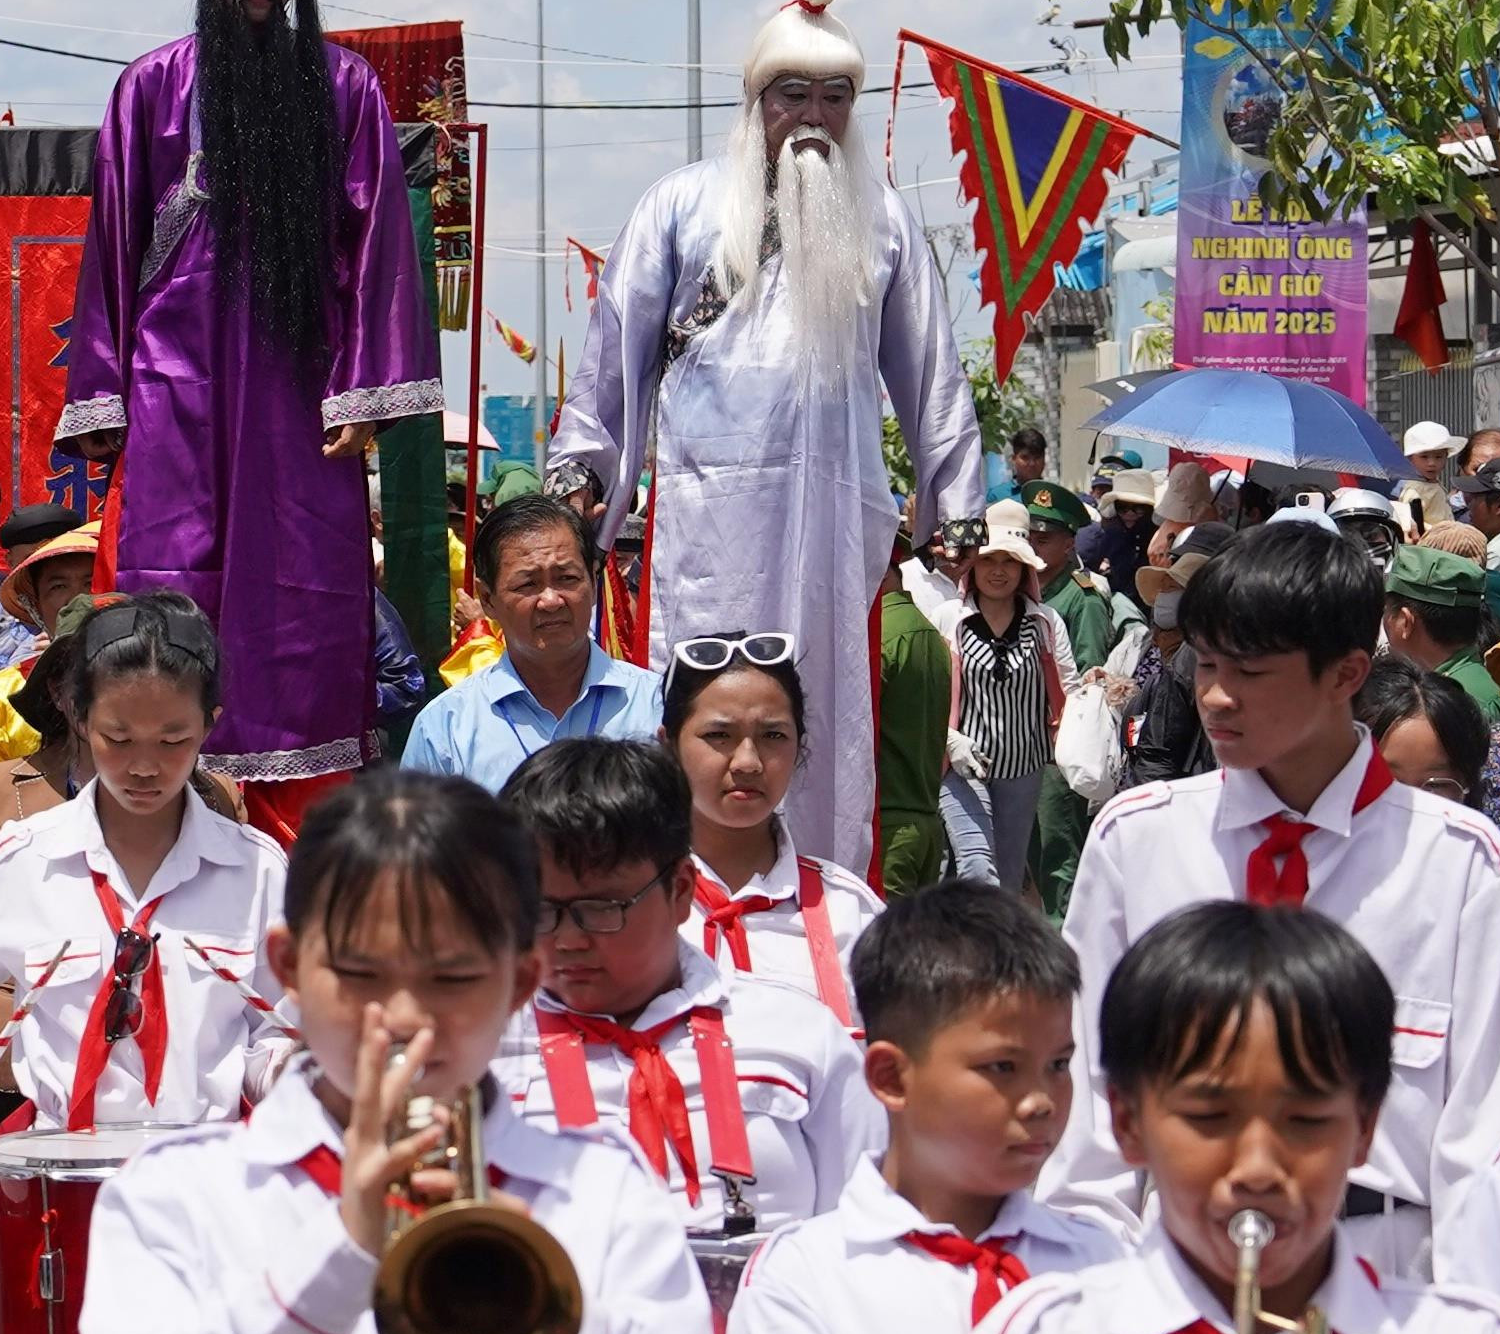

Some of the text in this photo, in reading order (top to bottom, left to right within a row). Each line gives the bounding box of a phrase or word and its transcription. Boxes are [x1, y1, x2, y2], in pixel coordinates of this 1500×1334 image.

[1231, 192, 1263, 225] LỄ
[1192, 233, 1353, 260] NGHINH ÔNG
[1218, 264, 1325, 297] CẦN GIỜ
[1202, 304, 1337, 335] NĂM 2025
